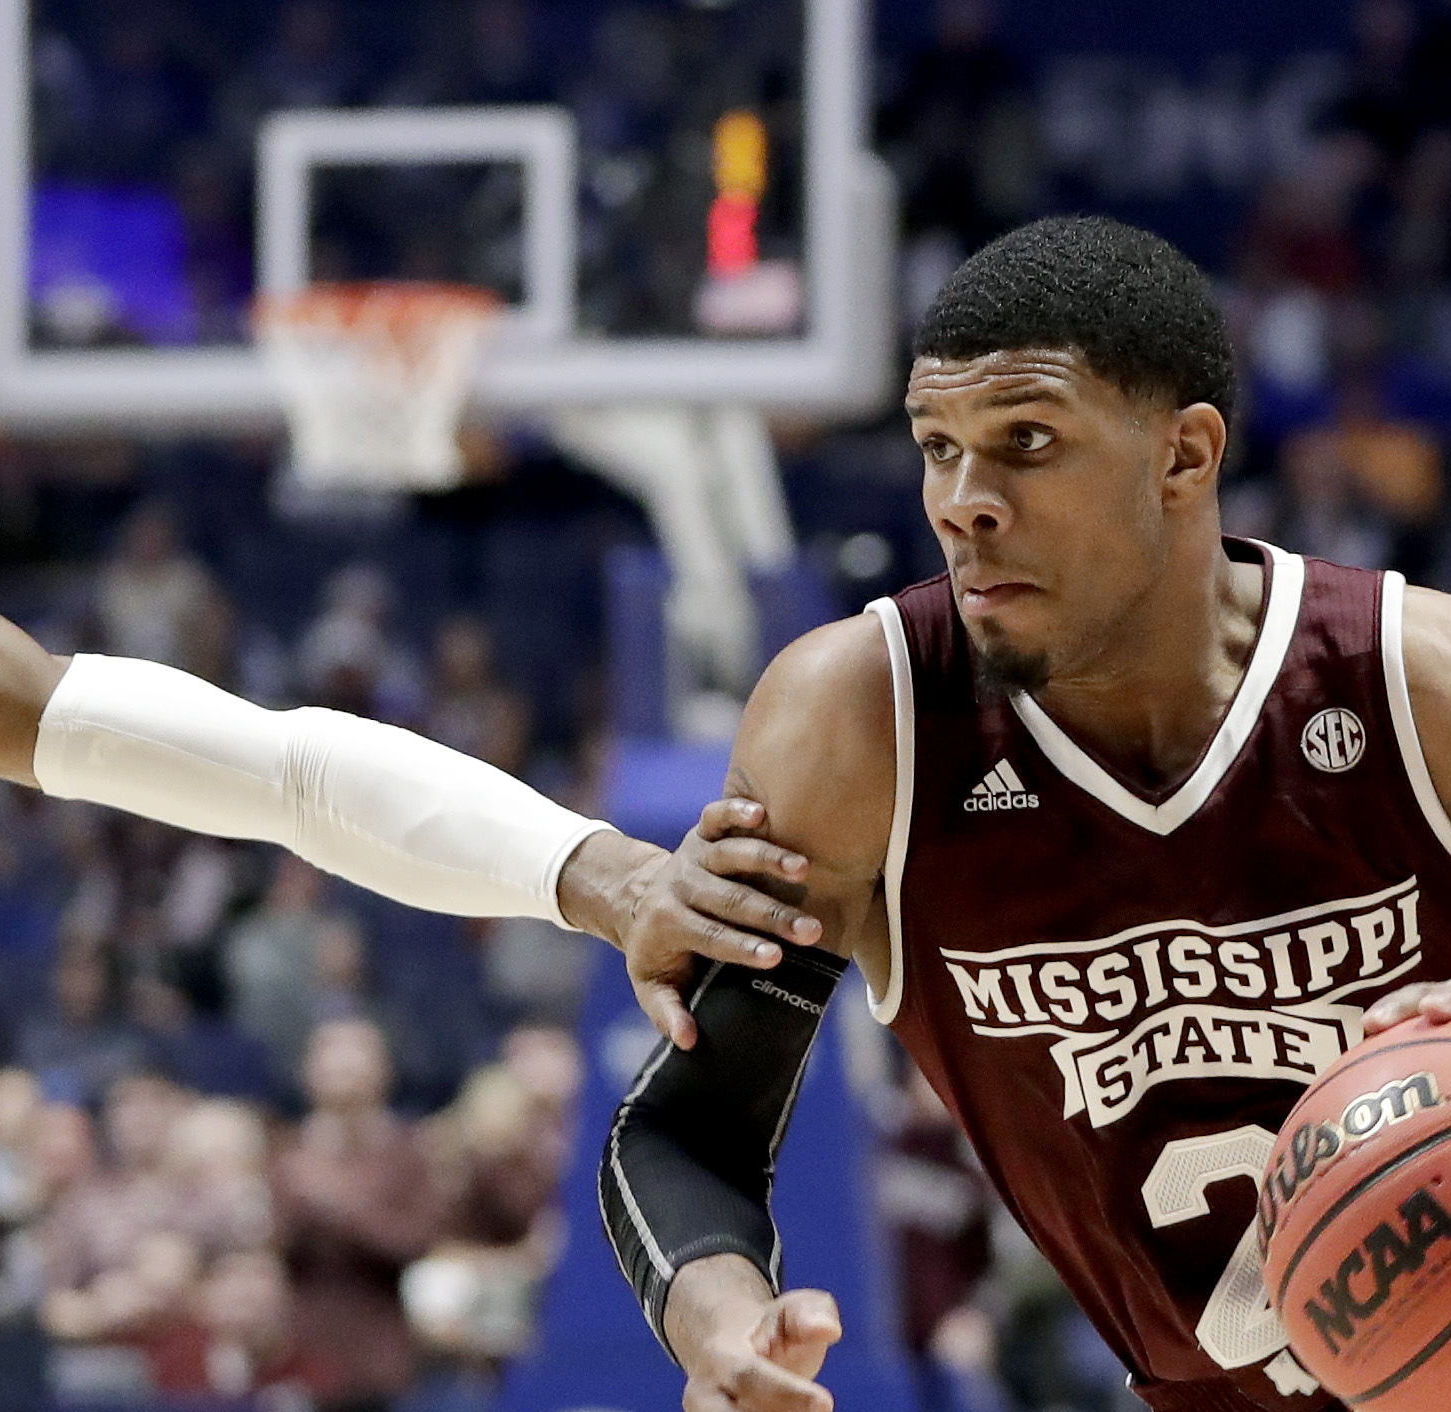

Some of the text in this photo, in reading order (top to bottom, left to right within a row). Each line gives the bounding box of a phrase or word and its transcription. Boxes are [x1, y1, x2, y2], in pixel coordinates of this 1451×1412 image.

[1306, 710, 1361, 769] SEC
[963, 790, 1040, 812] adidas
[945, 889, 1422, 1025] MISSISSIPPI
[1095, 1016, 1317, 1109] STATE
